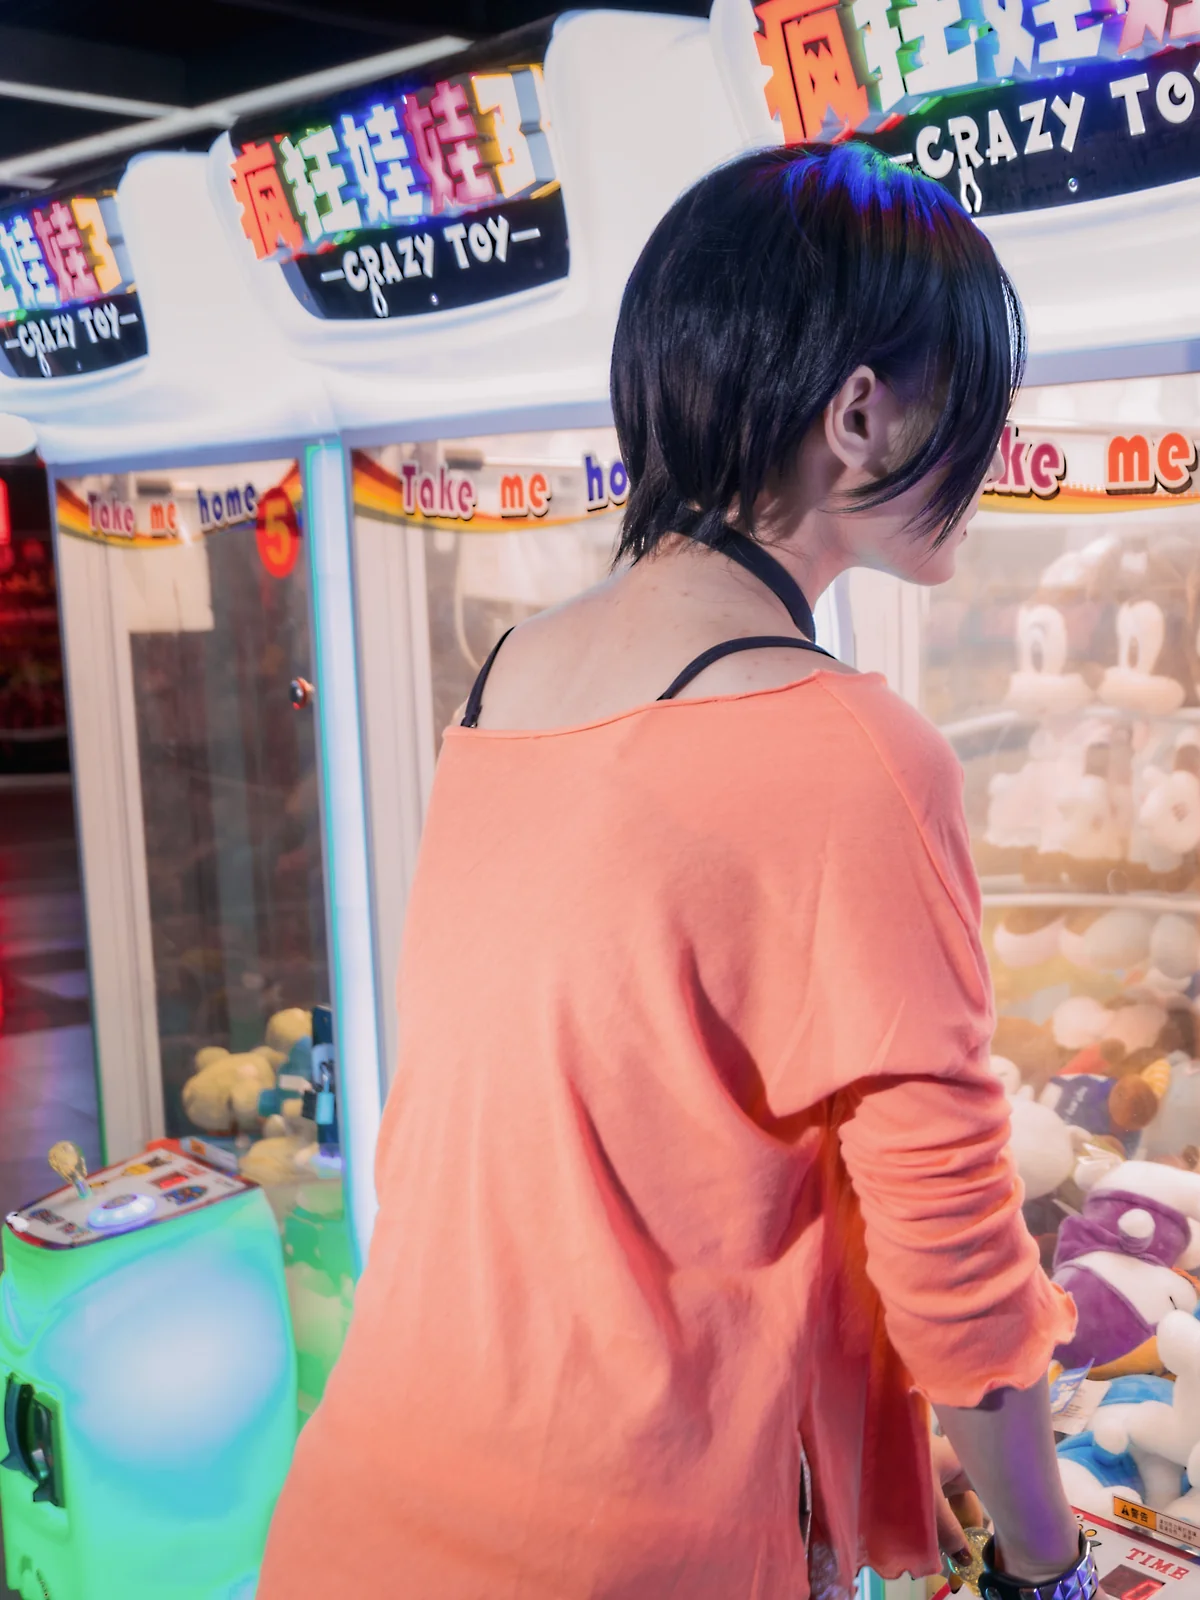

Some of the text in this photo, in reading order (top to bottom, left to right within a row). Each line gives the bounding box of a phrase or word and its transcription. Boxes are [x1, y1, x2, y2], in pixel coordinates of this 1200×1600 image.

[914, 92, 1086, 212] CRAZY
[342, 214, 510, 318] CRAZY TOY
[17, 301, 121, 378] CRAZY TOY
[400, 454, 630, 517] Take me ho
[999, 424, 1064, 493] ke
[1106, 430, 1195, 488] me
[86, 483, 258, 535] Take me home
[264, 497, 291, 566] 5
[1125, 1547, 1190, 1581] TIME
